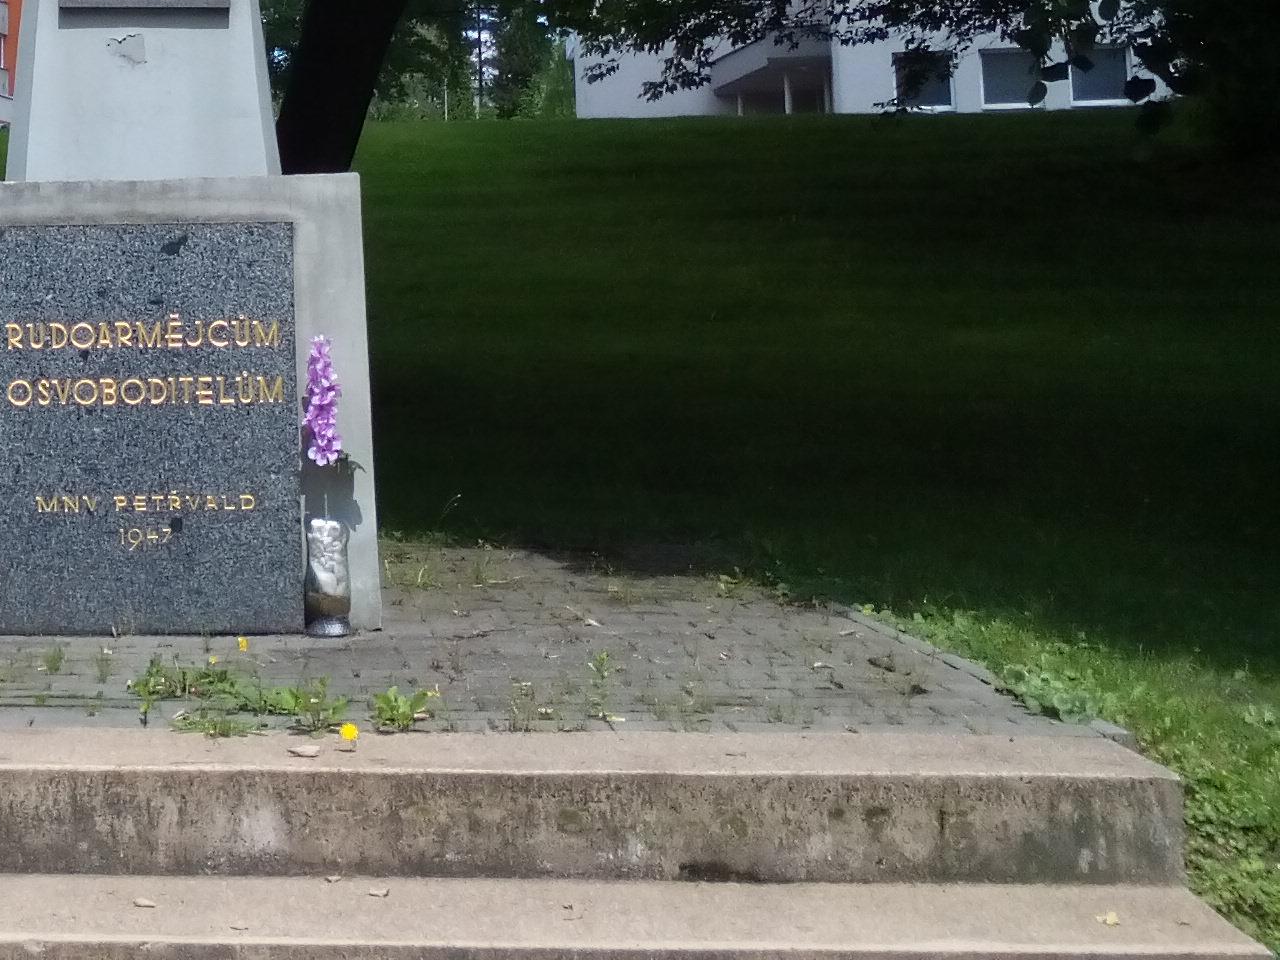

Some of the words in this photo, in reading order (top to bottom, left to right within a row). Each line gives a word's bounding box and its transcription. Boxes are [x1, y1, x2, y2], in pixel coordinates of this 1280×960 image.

[5, 314, 280, 349] RUDOARMĚJCŮM
[7, 371, 284, 406] OSVOBODITELŮM
[35, 495, 97, 513] MNV
[113, 490, 256, 511] PETŘVALD
[119, 528, 172, 551] 1947
